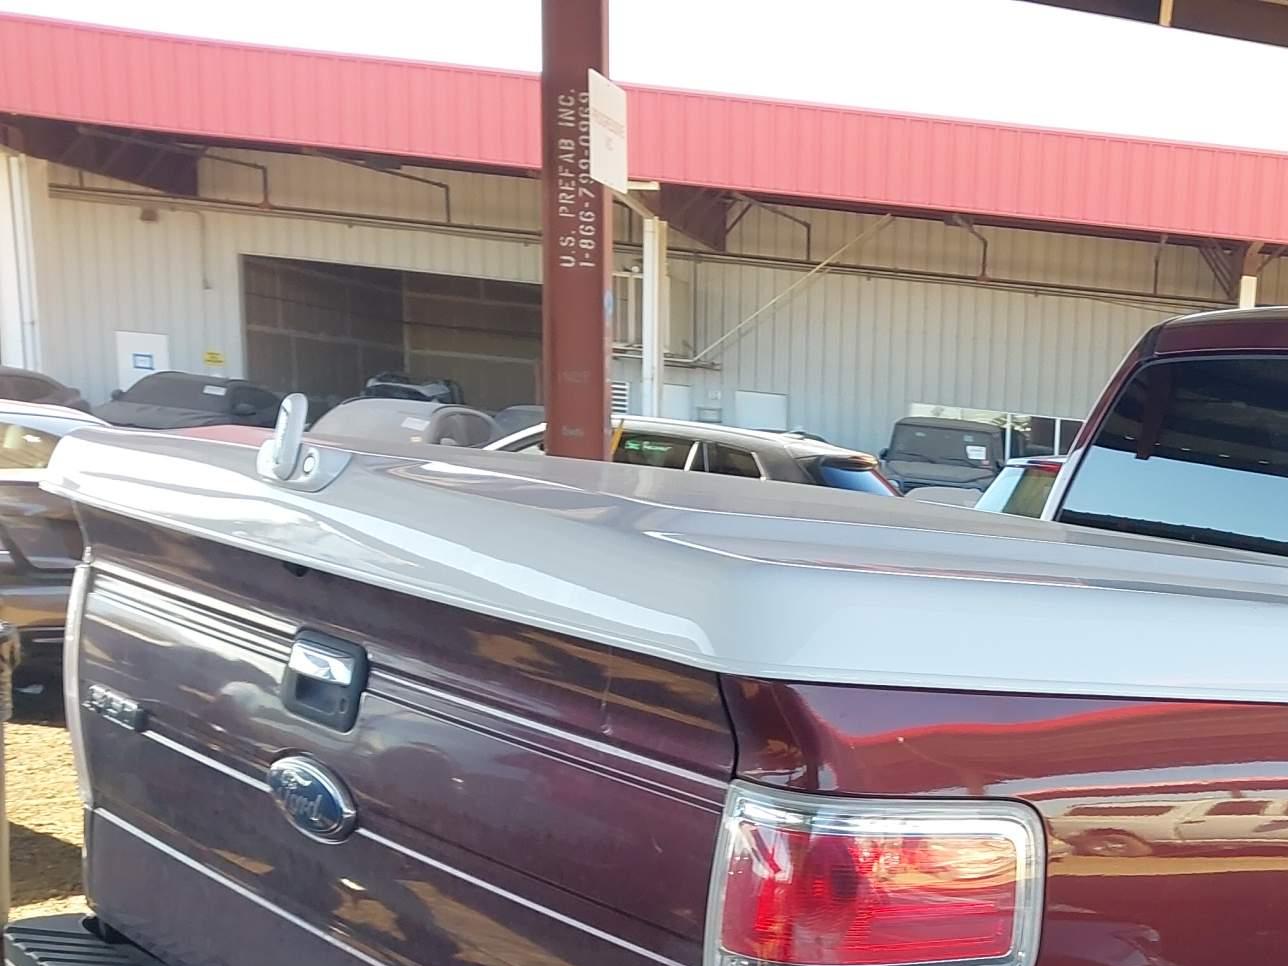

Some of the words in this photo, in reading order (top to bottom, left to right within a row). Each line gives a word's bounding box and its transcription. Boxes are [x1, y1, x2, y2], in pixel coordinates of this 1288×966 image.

[557, 88, 576, 127] INC.
[558, 138, 576, 217] PREFAB
[559, 230, 576, 267] U.S.
